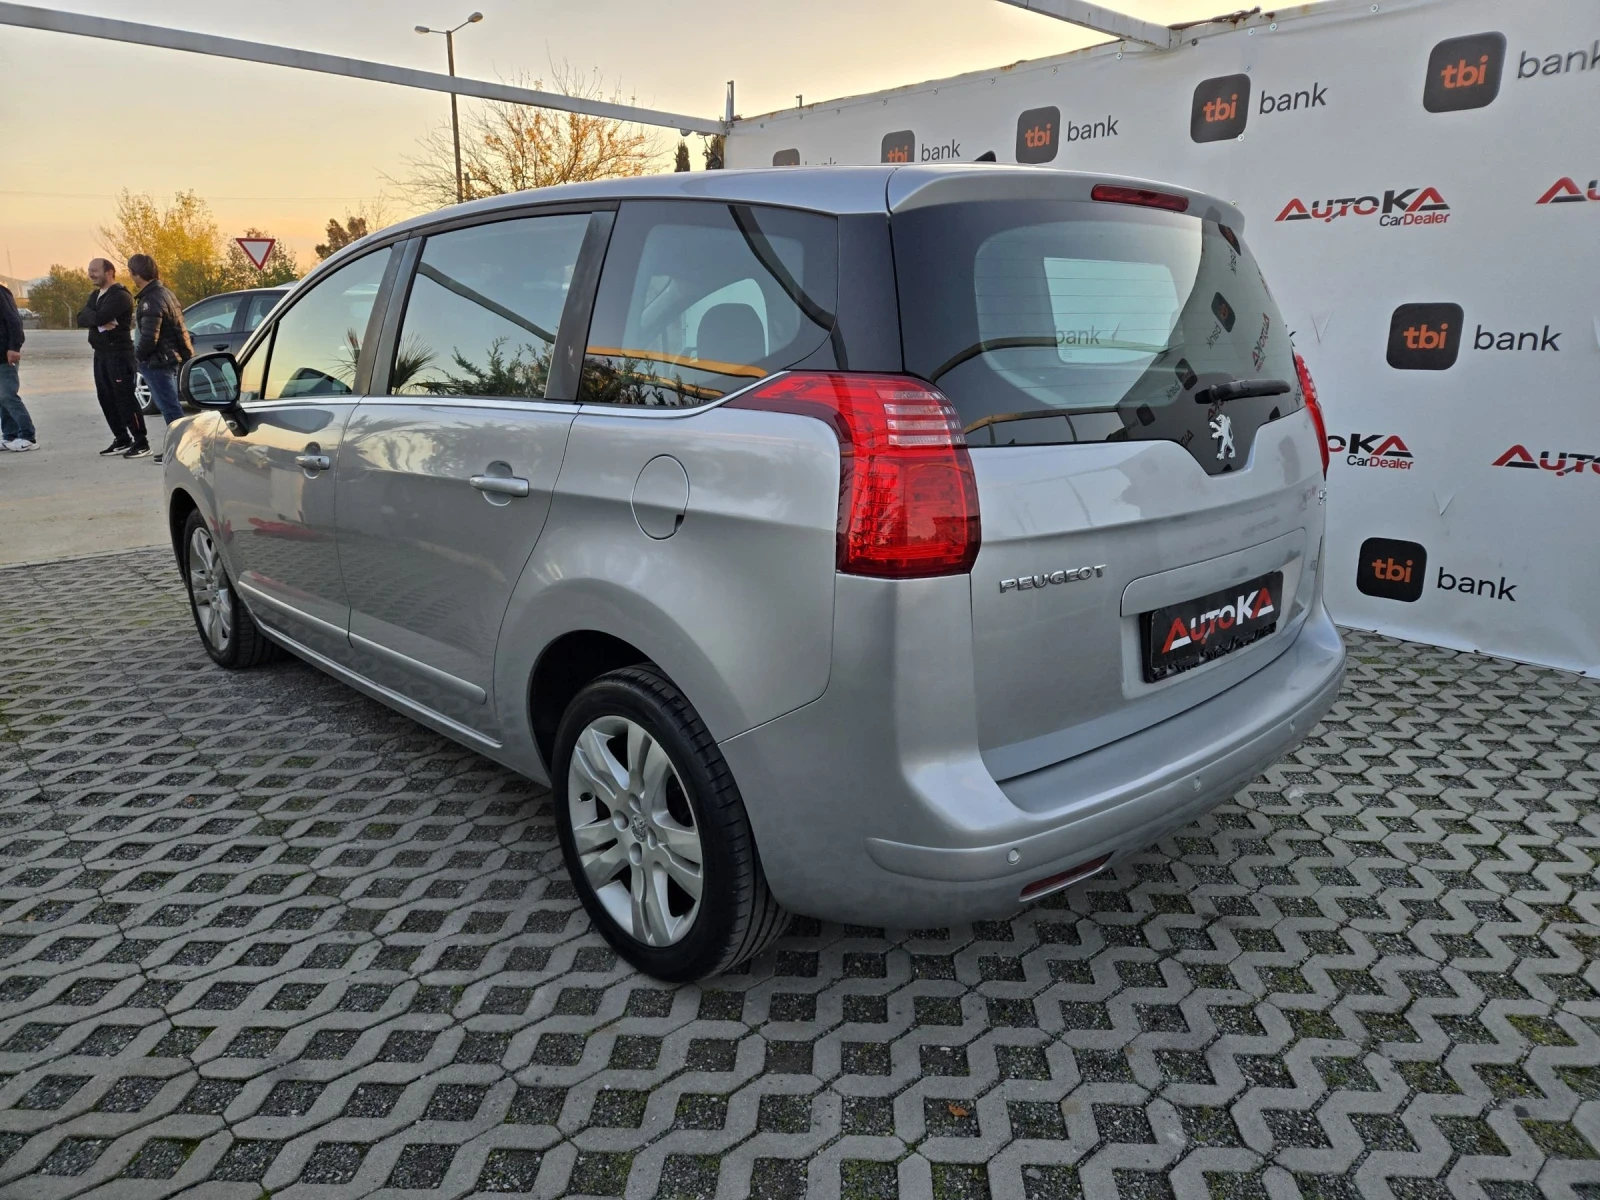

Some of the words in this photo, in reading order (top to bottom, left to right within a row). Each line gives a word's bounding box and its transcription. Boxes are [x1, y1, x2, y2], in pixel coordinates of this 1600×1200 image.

[1440, 54, 1489, 90] tbi
[1203, 93, 1238, 123] tbi
[1259, 82, 1328, 115] bank
[1025, 123, 1051, 149] tbi
[1066, 115, 1119, 143] bank
[920, 139, 961, 162] bank
[1274, 186, 1450, 223] AUTOKA
[1378, 212, 1450, 227] CarDealer
[1403, 323, 1449, 350] tbi
[1473, 325, 1563, 352] bank
[1346, 454, 1414, 470] CarDealer
[999, 564, 1107, 593] PEUGEOT
[1371, 558, 1413, 584] tbi
[1436, 566, 1517, 603] bank
[1161, 587, 1275, 655] AUTOKA
